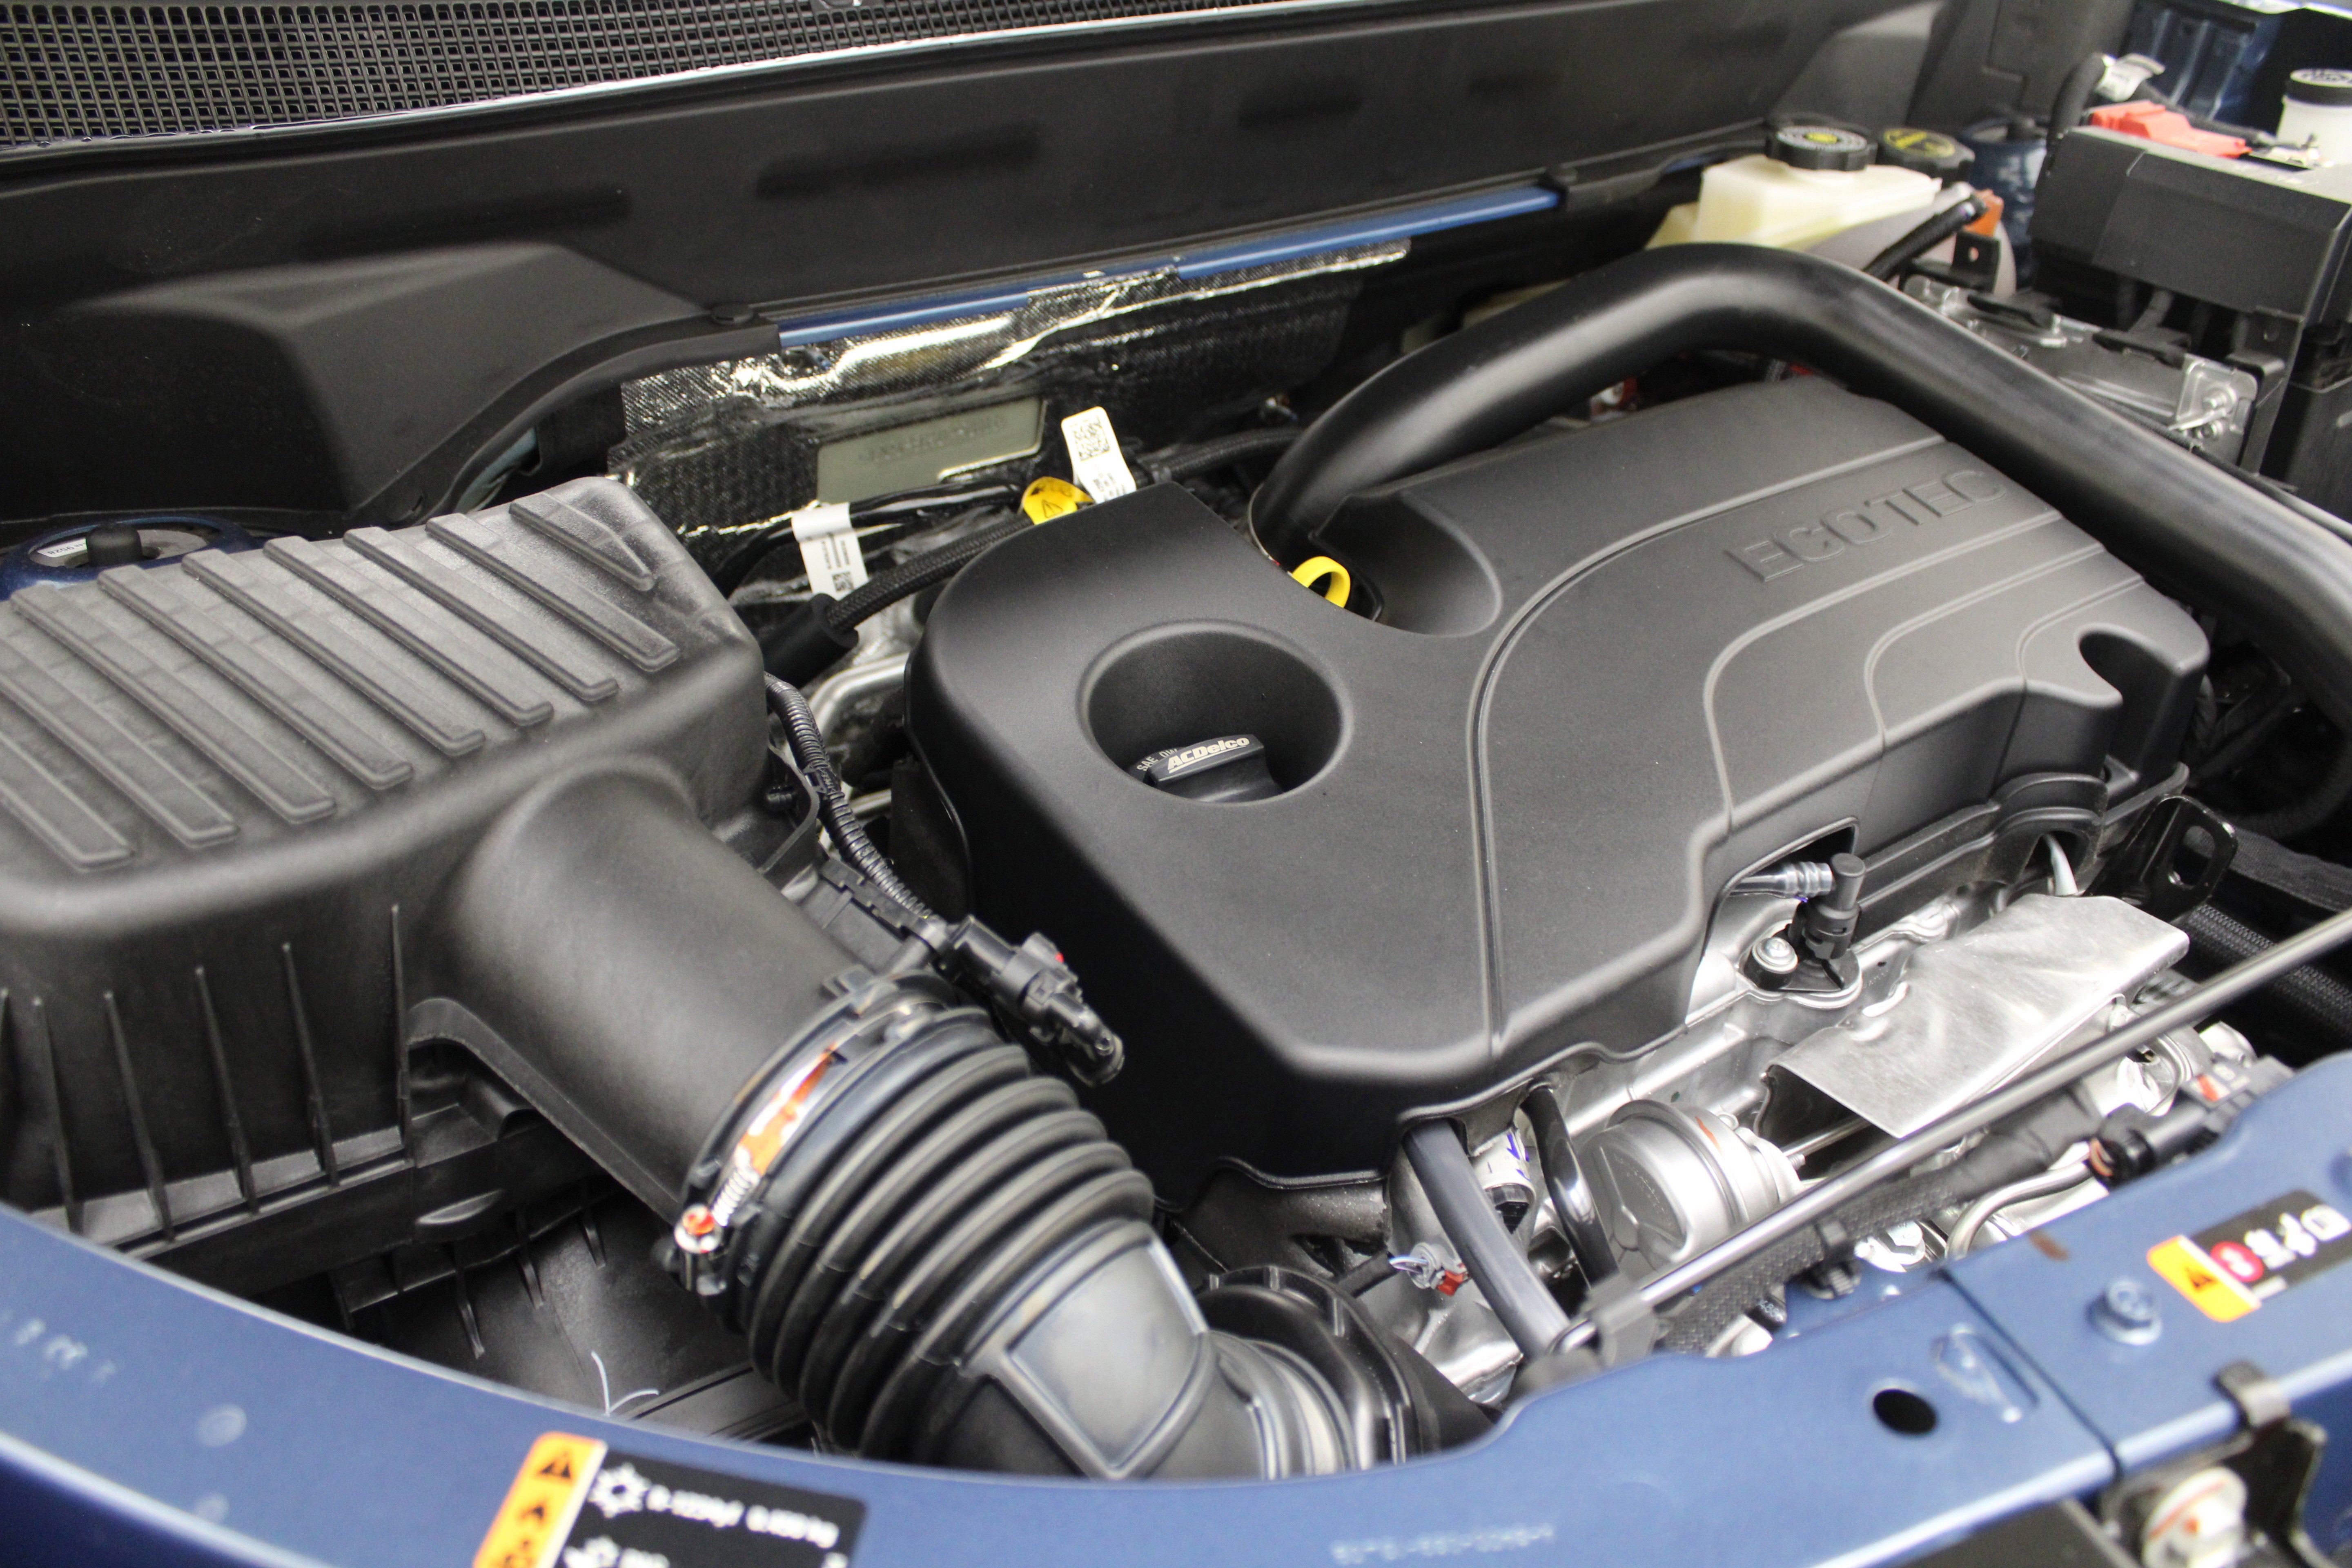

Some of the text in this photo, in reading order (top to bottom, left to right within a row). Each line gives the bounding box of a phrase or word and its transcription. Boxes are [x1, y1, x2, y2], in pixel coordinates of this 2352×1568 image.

[1723, 469, 2006, 583] ECOTEC
[1136, 756, 1158, 771] SAE
[1167, 737, 1250, 771] ACDelco
